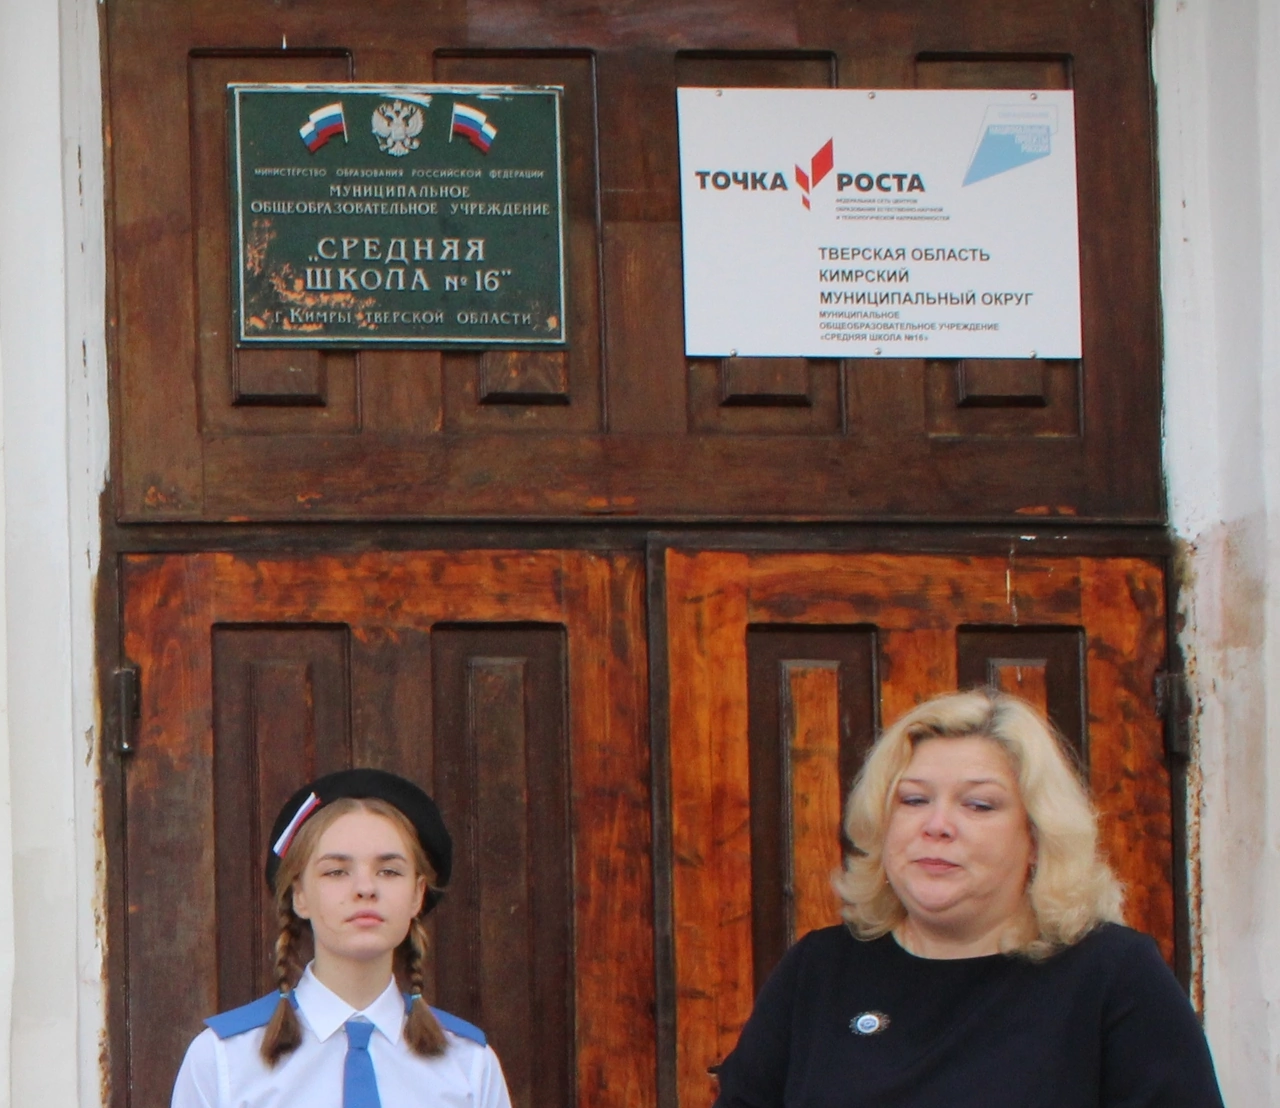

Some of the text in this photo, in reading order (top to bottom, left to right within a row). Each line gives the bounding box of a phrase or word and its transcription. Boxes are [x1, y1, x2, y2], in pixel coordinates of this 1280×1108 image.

[254, 167, 545, 179] МИНИСТЕРСТВО ОБРАЗОВАНИЯ РОССИЙСКОЙ ФЕДЕРАЦИИ
[695, 171, 925, 192] ТОЧКА РОСТА
[329, 184, 471, 198] МУНИЦИПАЛЬНОЕ
[250, 200, 551, 216] ОБЩЕОБРАЗОВАТЕЛЬНОЕ УЧРЕЖДЕНИЕ
[818, 247, 990, 262] ТВЕРСКАЯ ОБЛАСТЬ
[305, 267, 430, 291] ШКОЛА
[818, 268, 909, 283] КИМРСКИЙ
[819, 290, 1034, 307] МУНИЦИПАЛЬНЫЙ ОКРУГ
[457, 312, 532, 325] ОБЛАСТИ
[818, 311, 900, 320] МУНИЦИПАЛЬНОЕ
[819, 322, 1000, 332] ОБЩЕОБРАЗОВАТЕЛЬНОЕ УЧРЕЖДЕНИЕ
[869, 334, 902, 342] ШКОЛА
